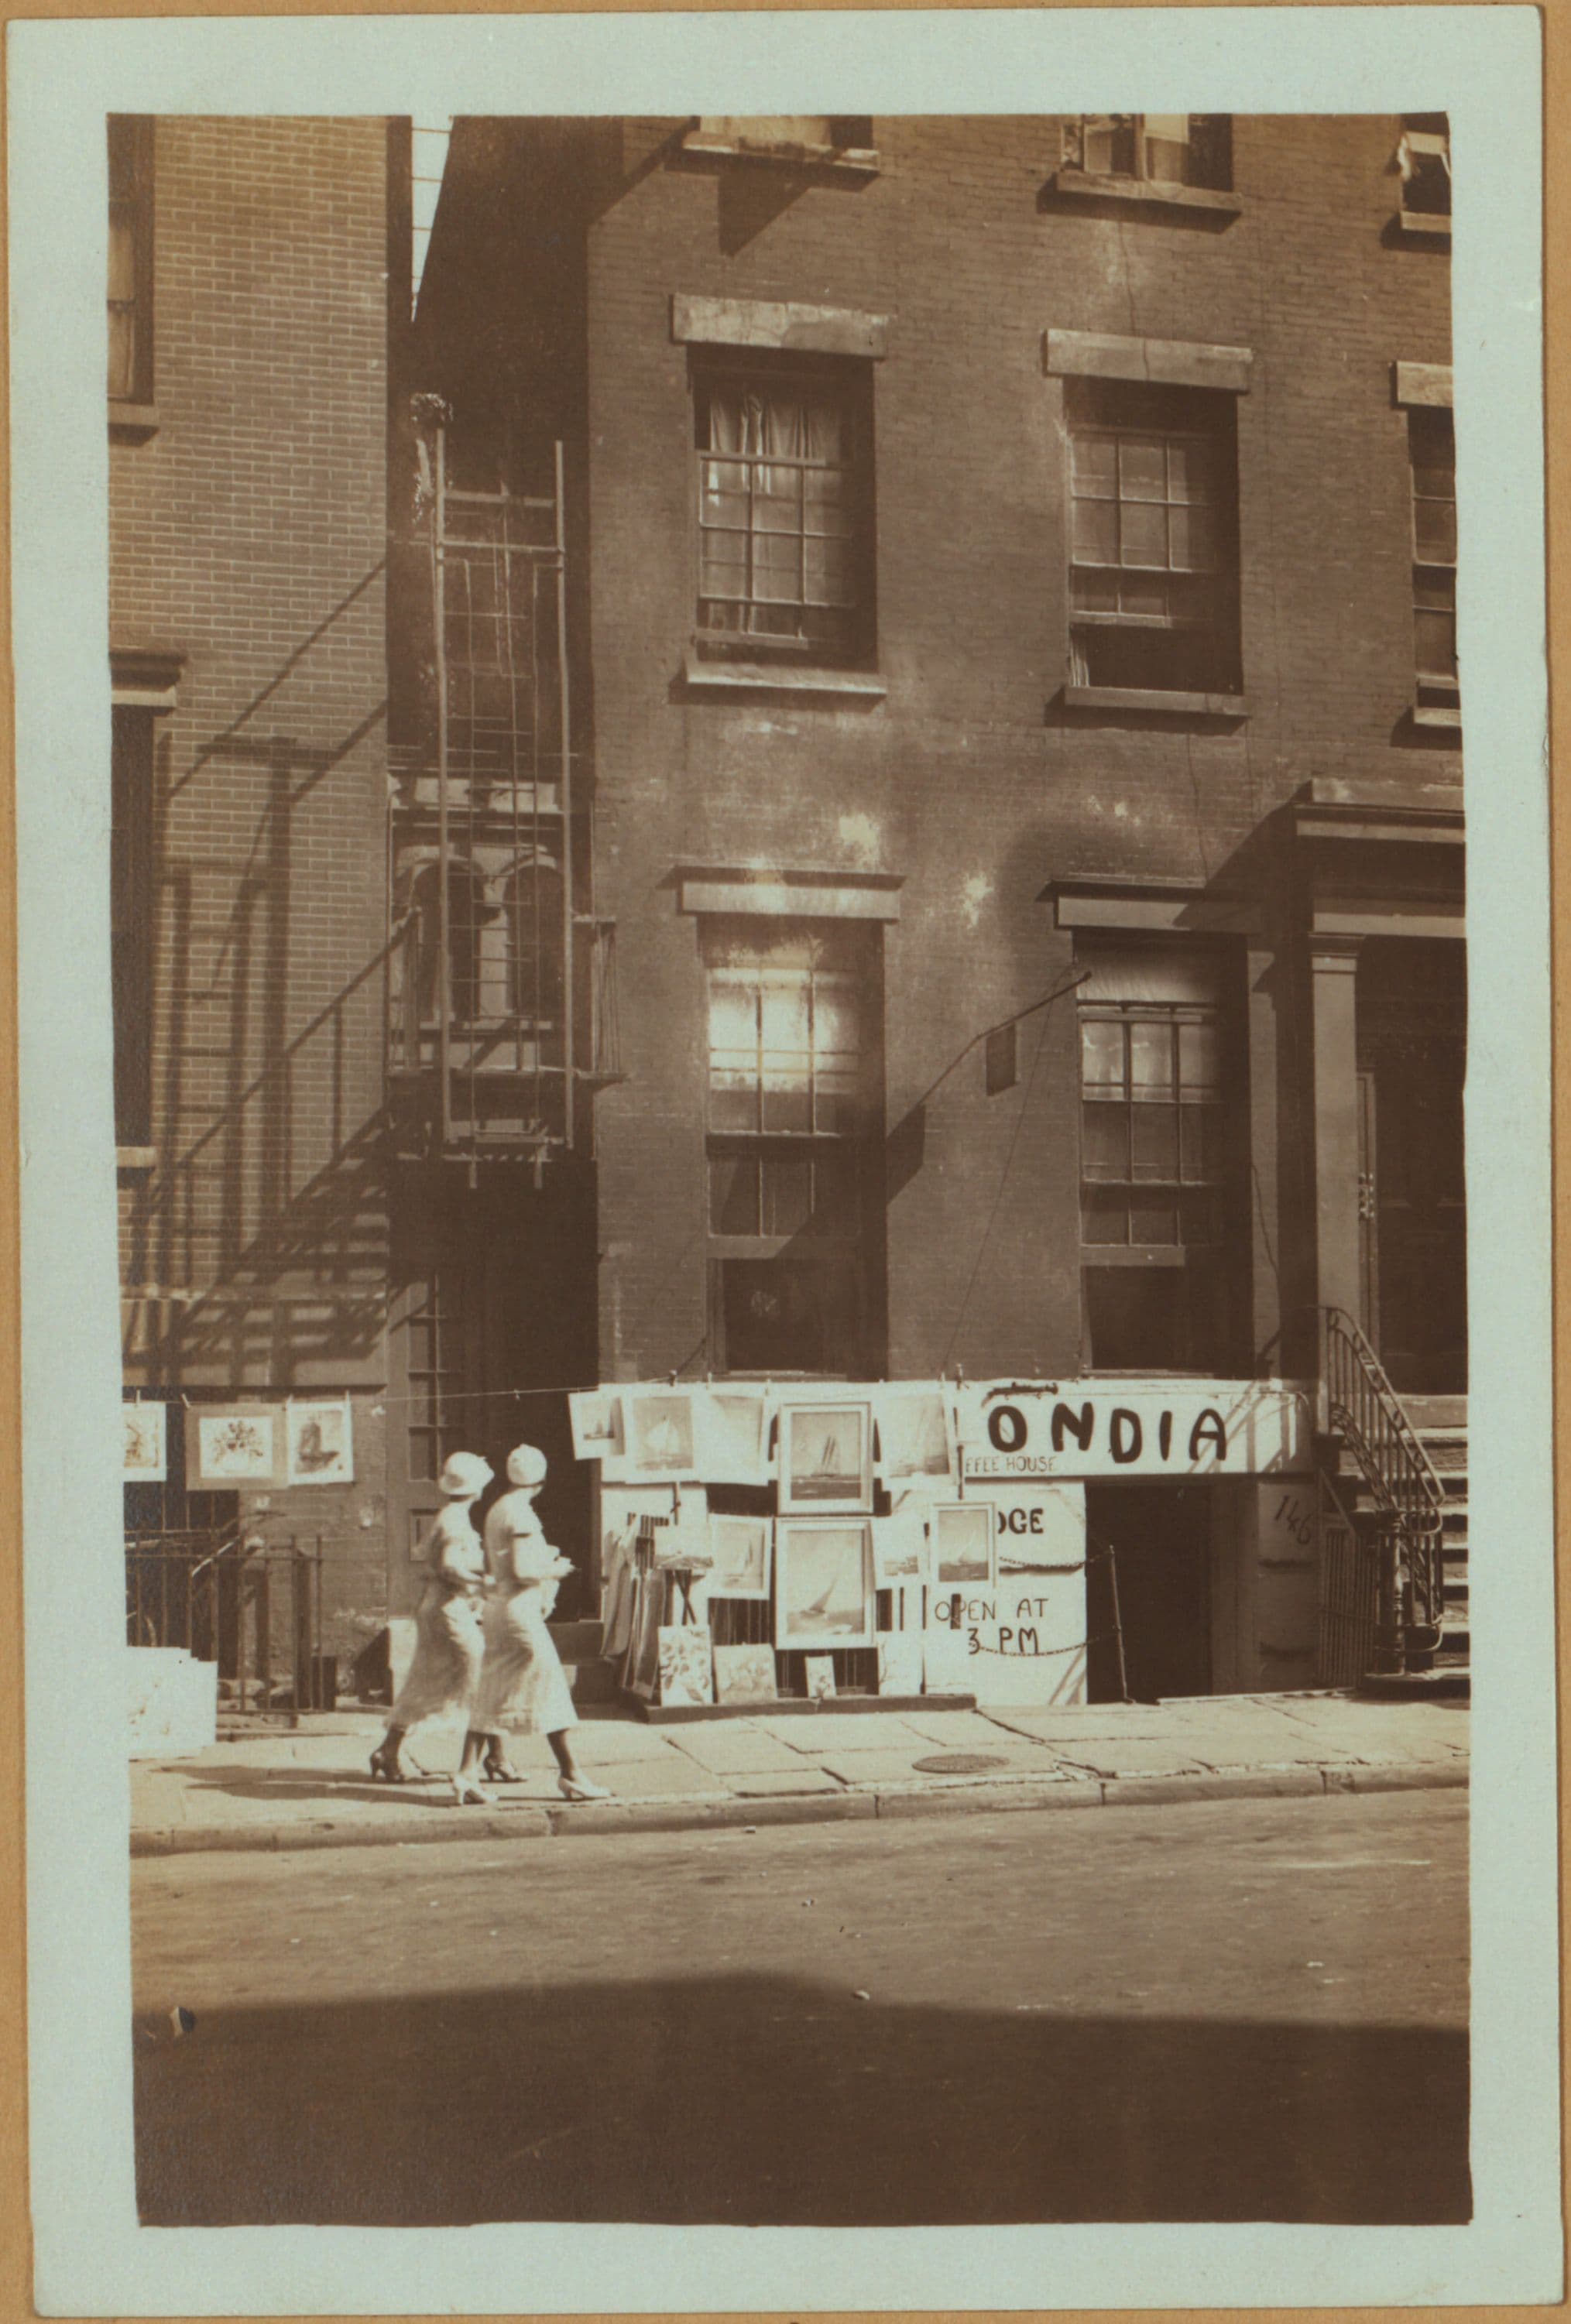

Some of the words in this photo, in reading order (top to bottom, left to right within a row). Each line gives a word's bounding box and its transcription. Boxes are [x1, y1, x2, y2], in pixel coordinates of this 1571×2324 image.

[987, 1401, 1227, 1464] ONDIA
[1007, 1455, 1057, 1472] HOUSE
[935, 1599, 996, 1621] OPEN
[1017, 1598, 1049, 1618] AT
[966, 1627, 981, 1655] 3
[999, 1627, 1038, 1655] PM
